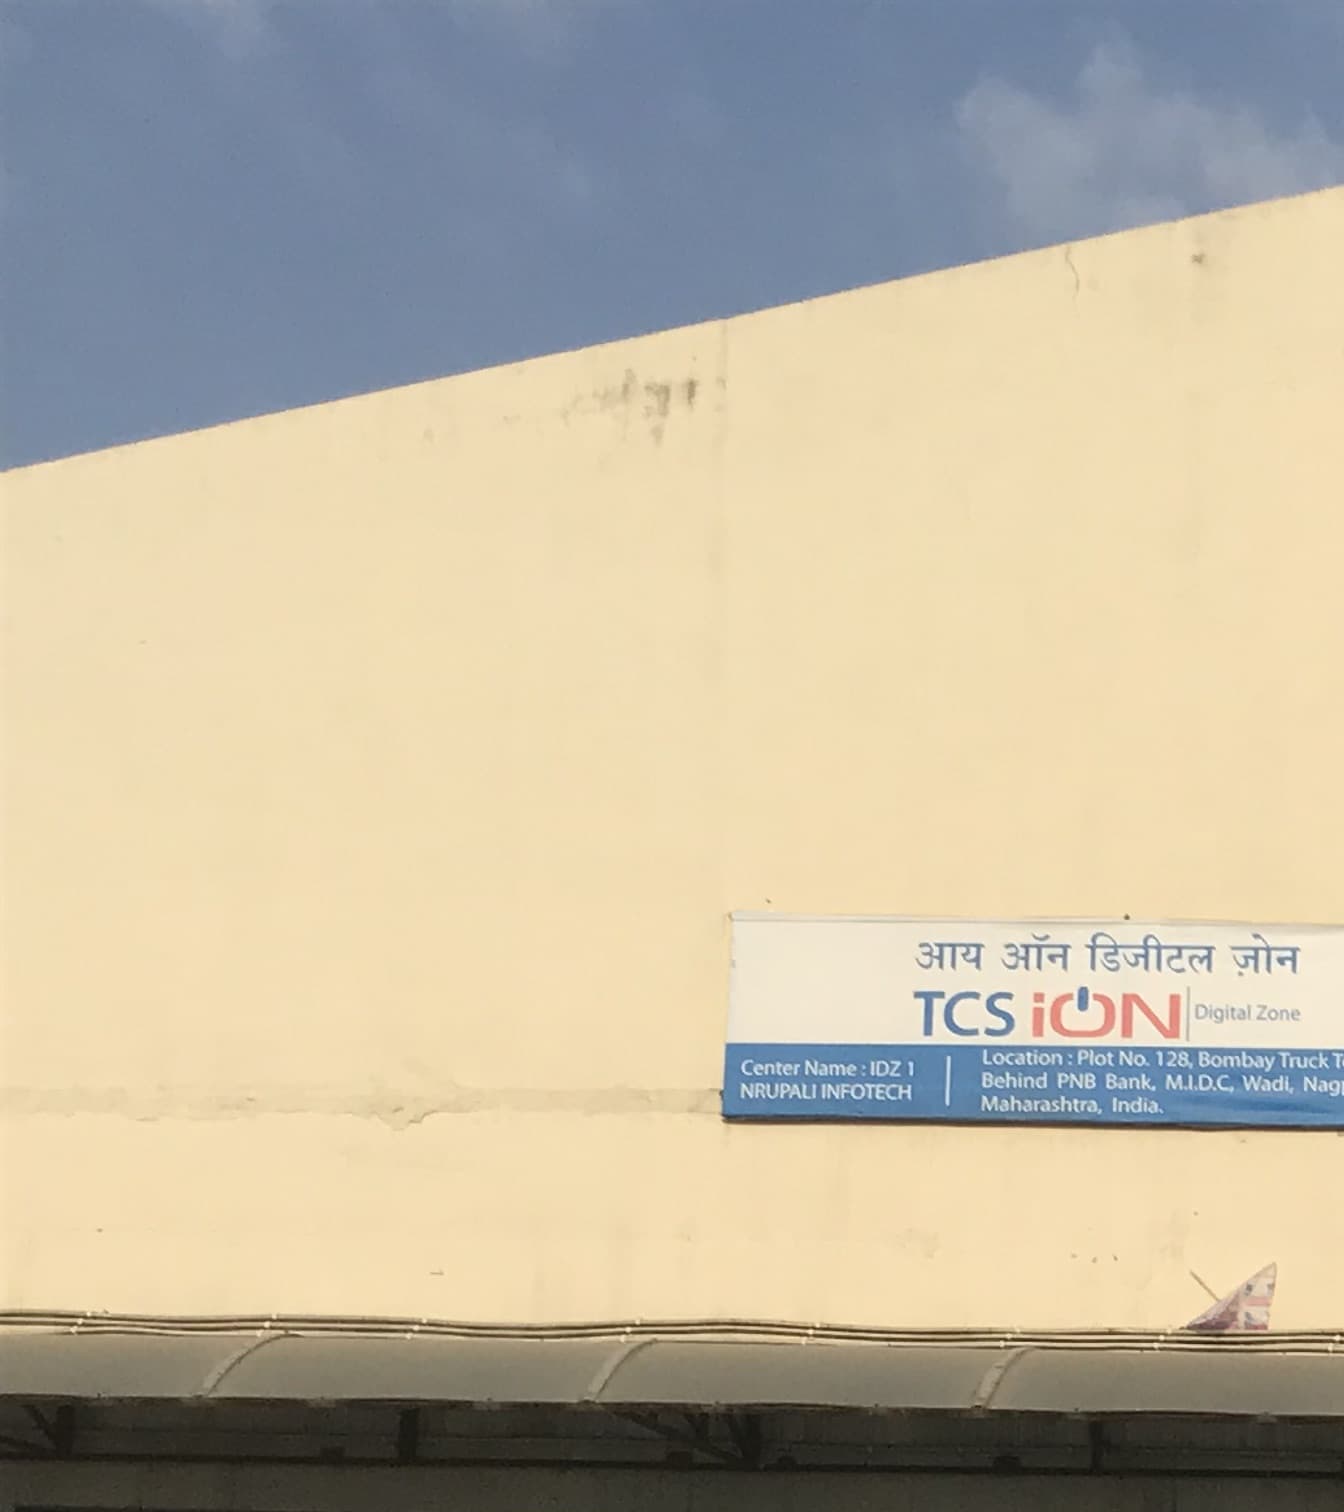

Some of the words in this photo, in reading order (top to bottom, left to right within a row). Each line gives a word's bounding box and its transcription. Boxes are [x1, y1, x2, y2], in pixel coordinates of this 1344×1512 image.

[915, 940, 985, 972] आय
[1001, 932, 1071, 973] ऑन
[1085, 932, 1216, 974] डिजीटल
[913, 990, 1015, 1038] TCS
[1194, 1002, 1251, 1025] Digital
[1256, 1003, 1301, 1022] Zone
[740, 1058, 800, 1077] Center
[804, 1059, 857, 1077] Name
[869, 1060, 901, 1077] IDZ
[907, 1060, 915, 1077] 1
[982, 1048, 1063, 1066] Location
[1077, 1049, 1113, 1067] Plot
[1119, 1050, 1149, 1067] No.
[1155, 1050, 1193, 1070] 128,
[1198, 1050, 1276, 1072] Bombay
[1278, 1051, 1330, 1070] Truck
[740, 1082, 817, 1100] NRUPALI
[821, 1083, 912, 1101] INFOTECH
[981, 1071, 1048, 1089] Behind
[1057, 1072, 1097, 1090] PNB
[1105, 1073, 1156, 1092] Bank,
[1242, 1075, 1294, 1094] Wadi,
[980, 1095, 1103, 1115] Maharashtra,
[1112, 1096, 1164, 1115] India.
